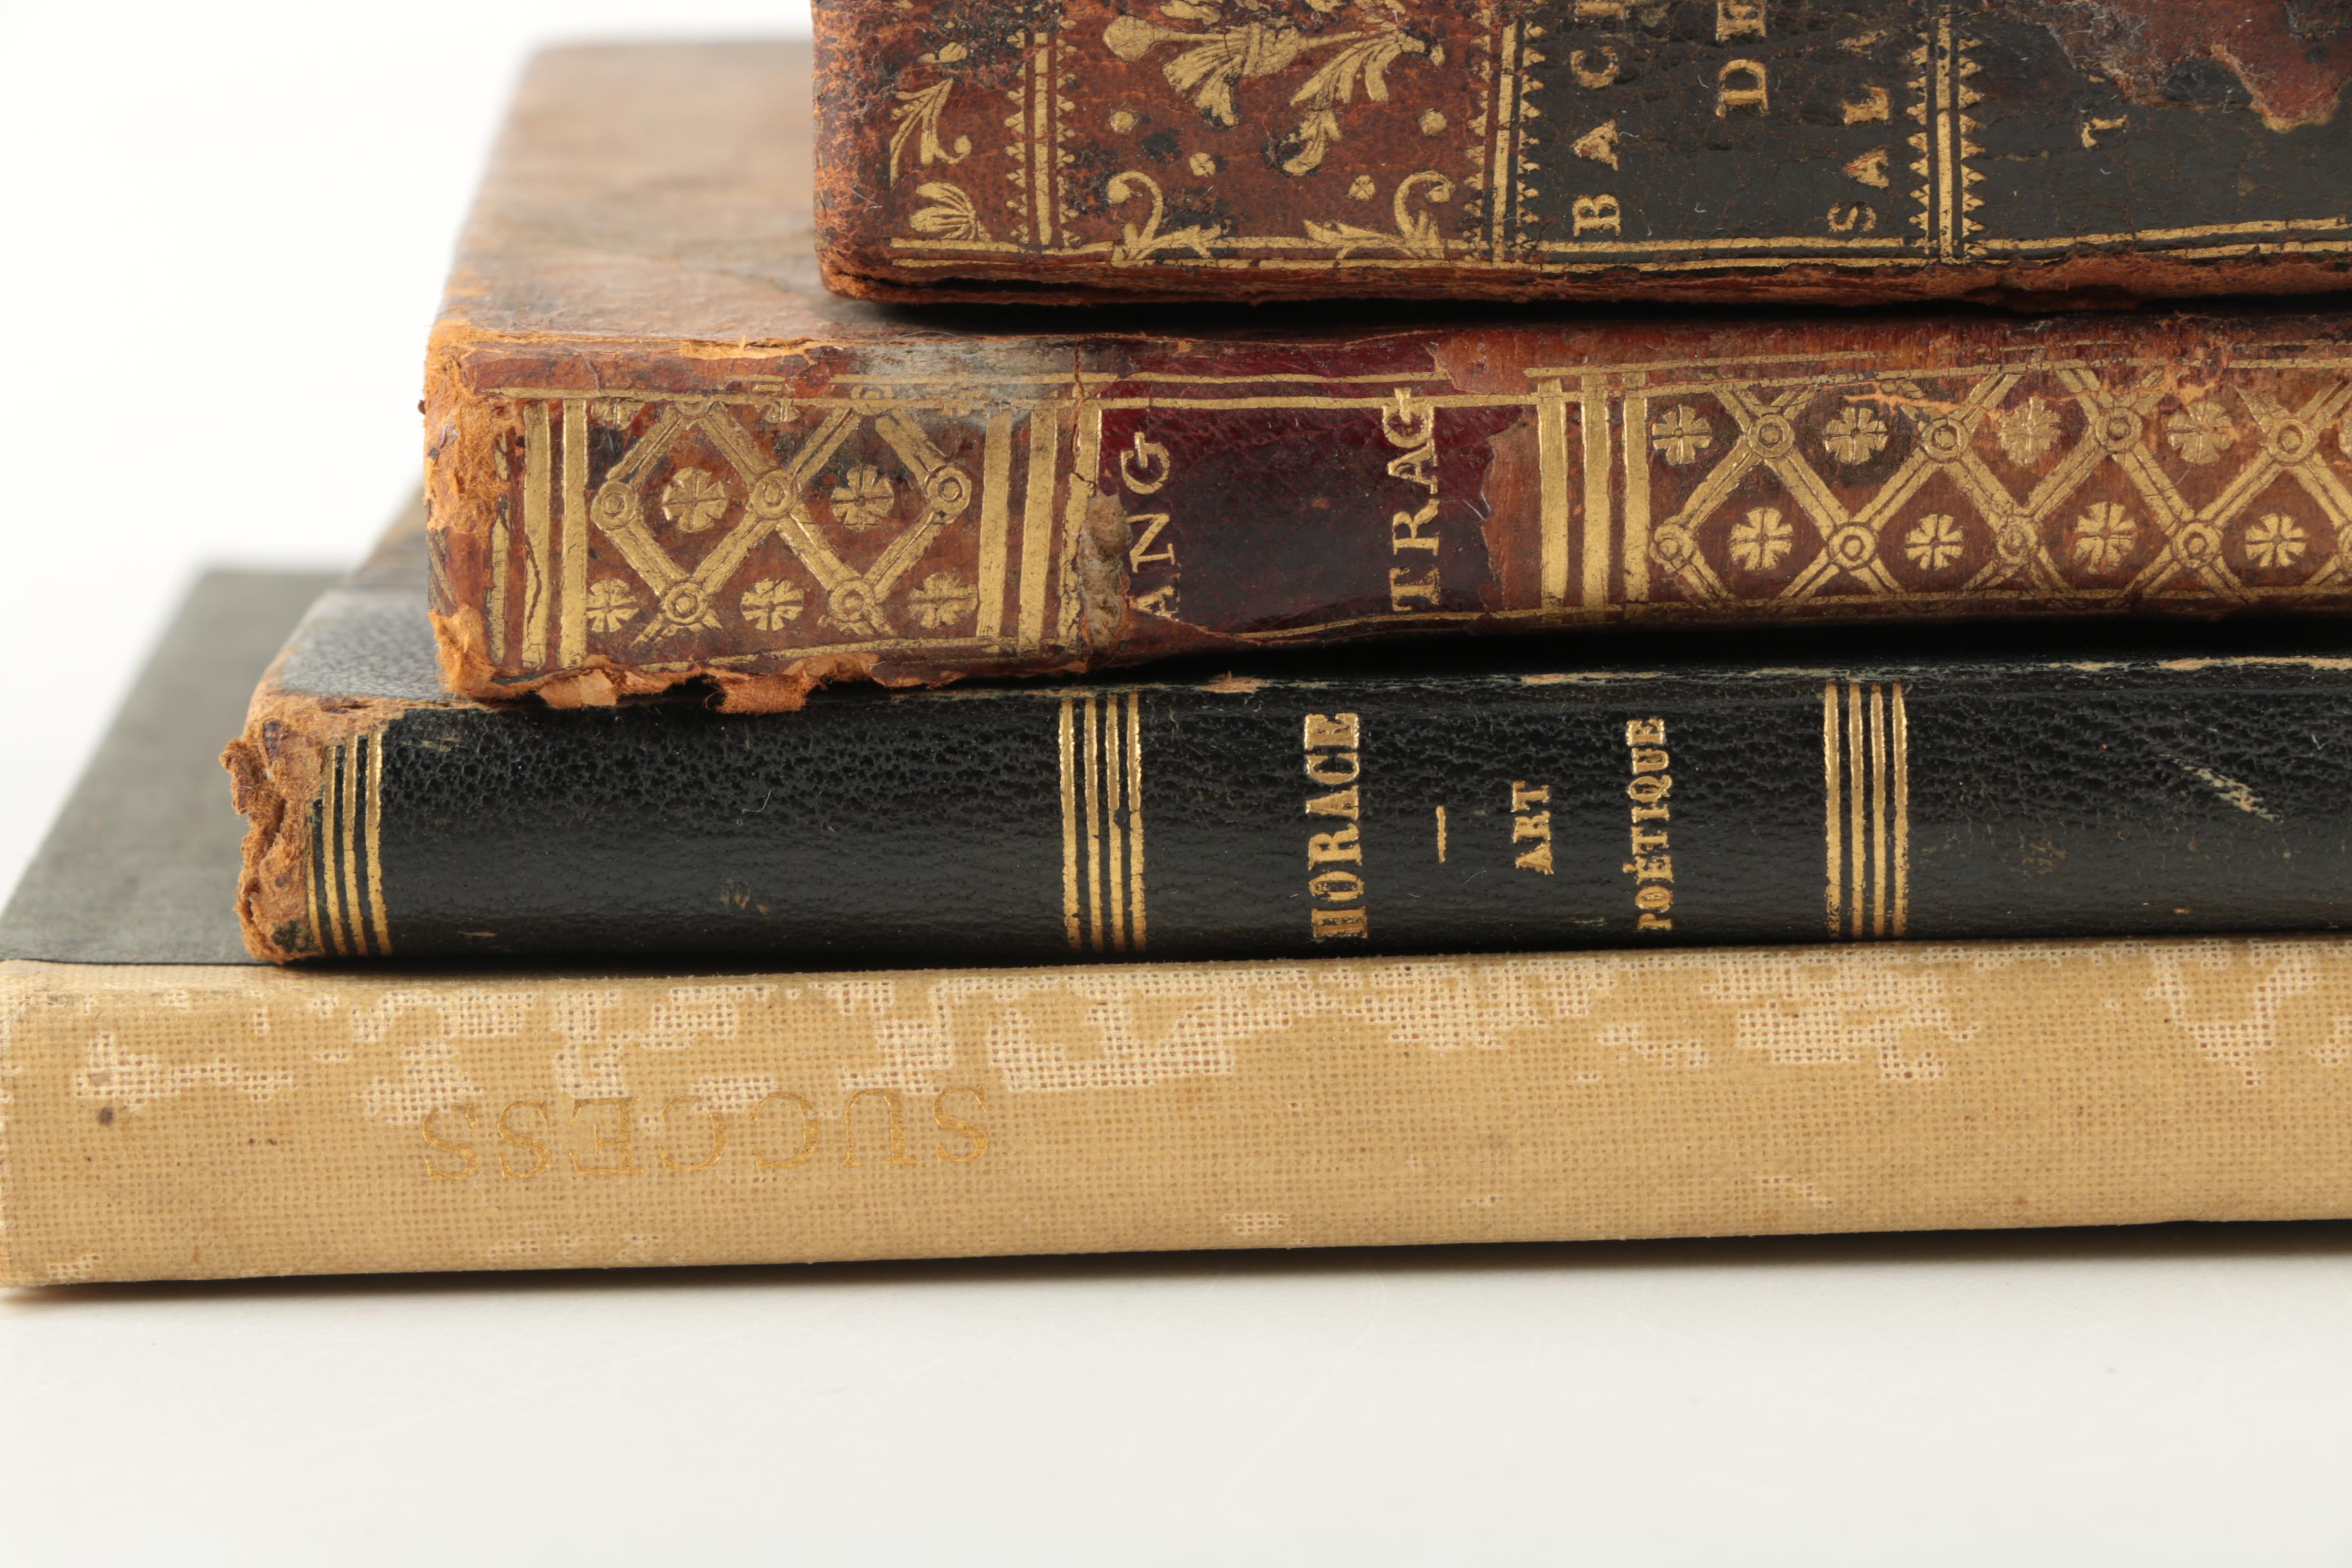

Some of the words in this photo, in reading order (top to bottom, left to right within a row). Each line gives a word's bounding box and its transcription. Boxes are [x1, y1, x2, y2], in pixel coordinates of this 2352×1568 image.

[1381, 387, 1440, 612] TRAG
[1304, 712, 1368, 939] HORACE
[1511, 780, 1554, 875] ART
[1622, 718, 1675, 931] POÉTIQUE
[421, 1084, 990, 1181] SUCCESS
